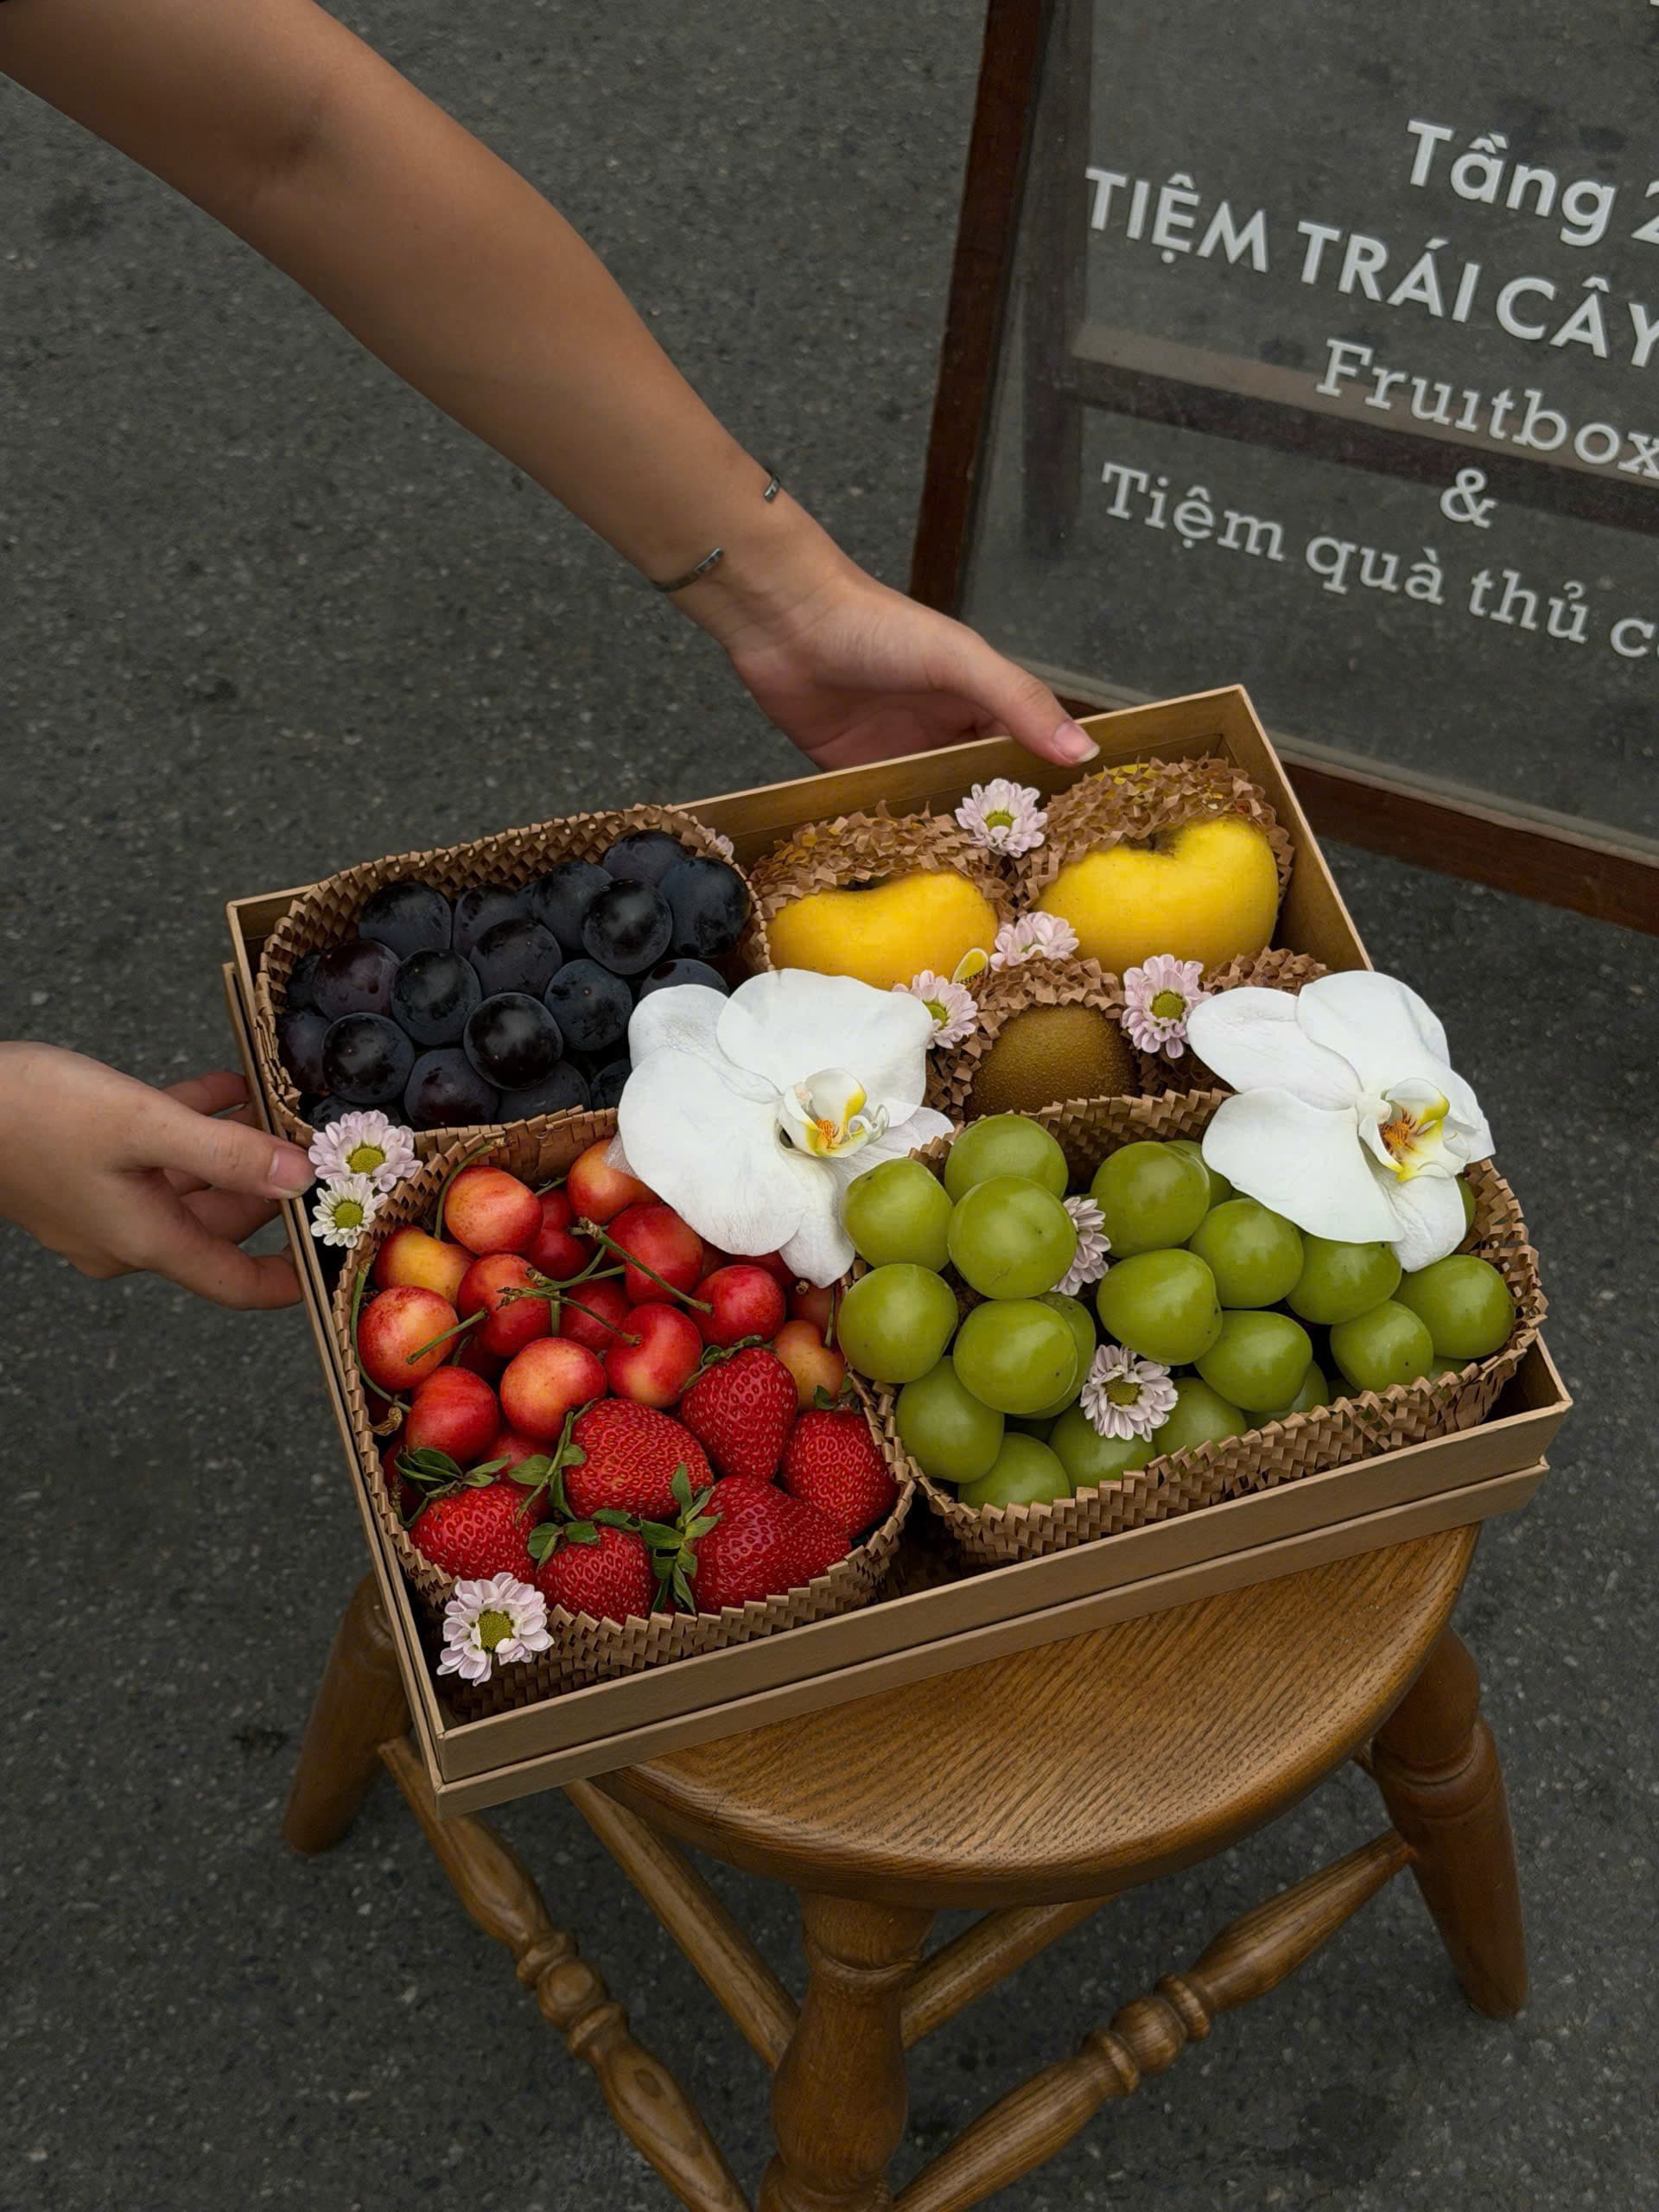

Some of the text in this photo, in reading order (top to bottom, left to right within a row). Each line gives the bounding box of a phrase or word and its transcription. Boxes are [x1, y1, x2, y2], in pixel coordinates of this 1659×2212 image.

[1407, 119, 1616, 247] Tầng
[1085, 168, 1659, 367] TIỆM TRÁI CÂY
[1101, 462, 1285, 562] Tiệm
[1305, 536, 1444, 605] quà
[1469, 569, 1588, 644] thủ
[1440, 468, 1497, 528] &
